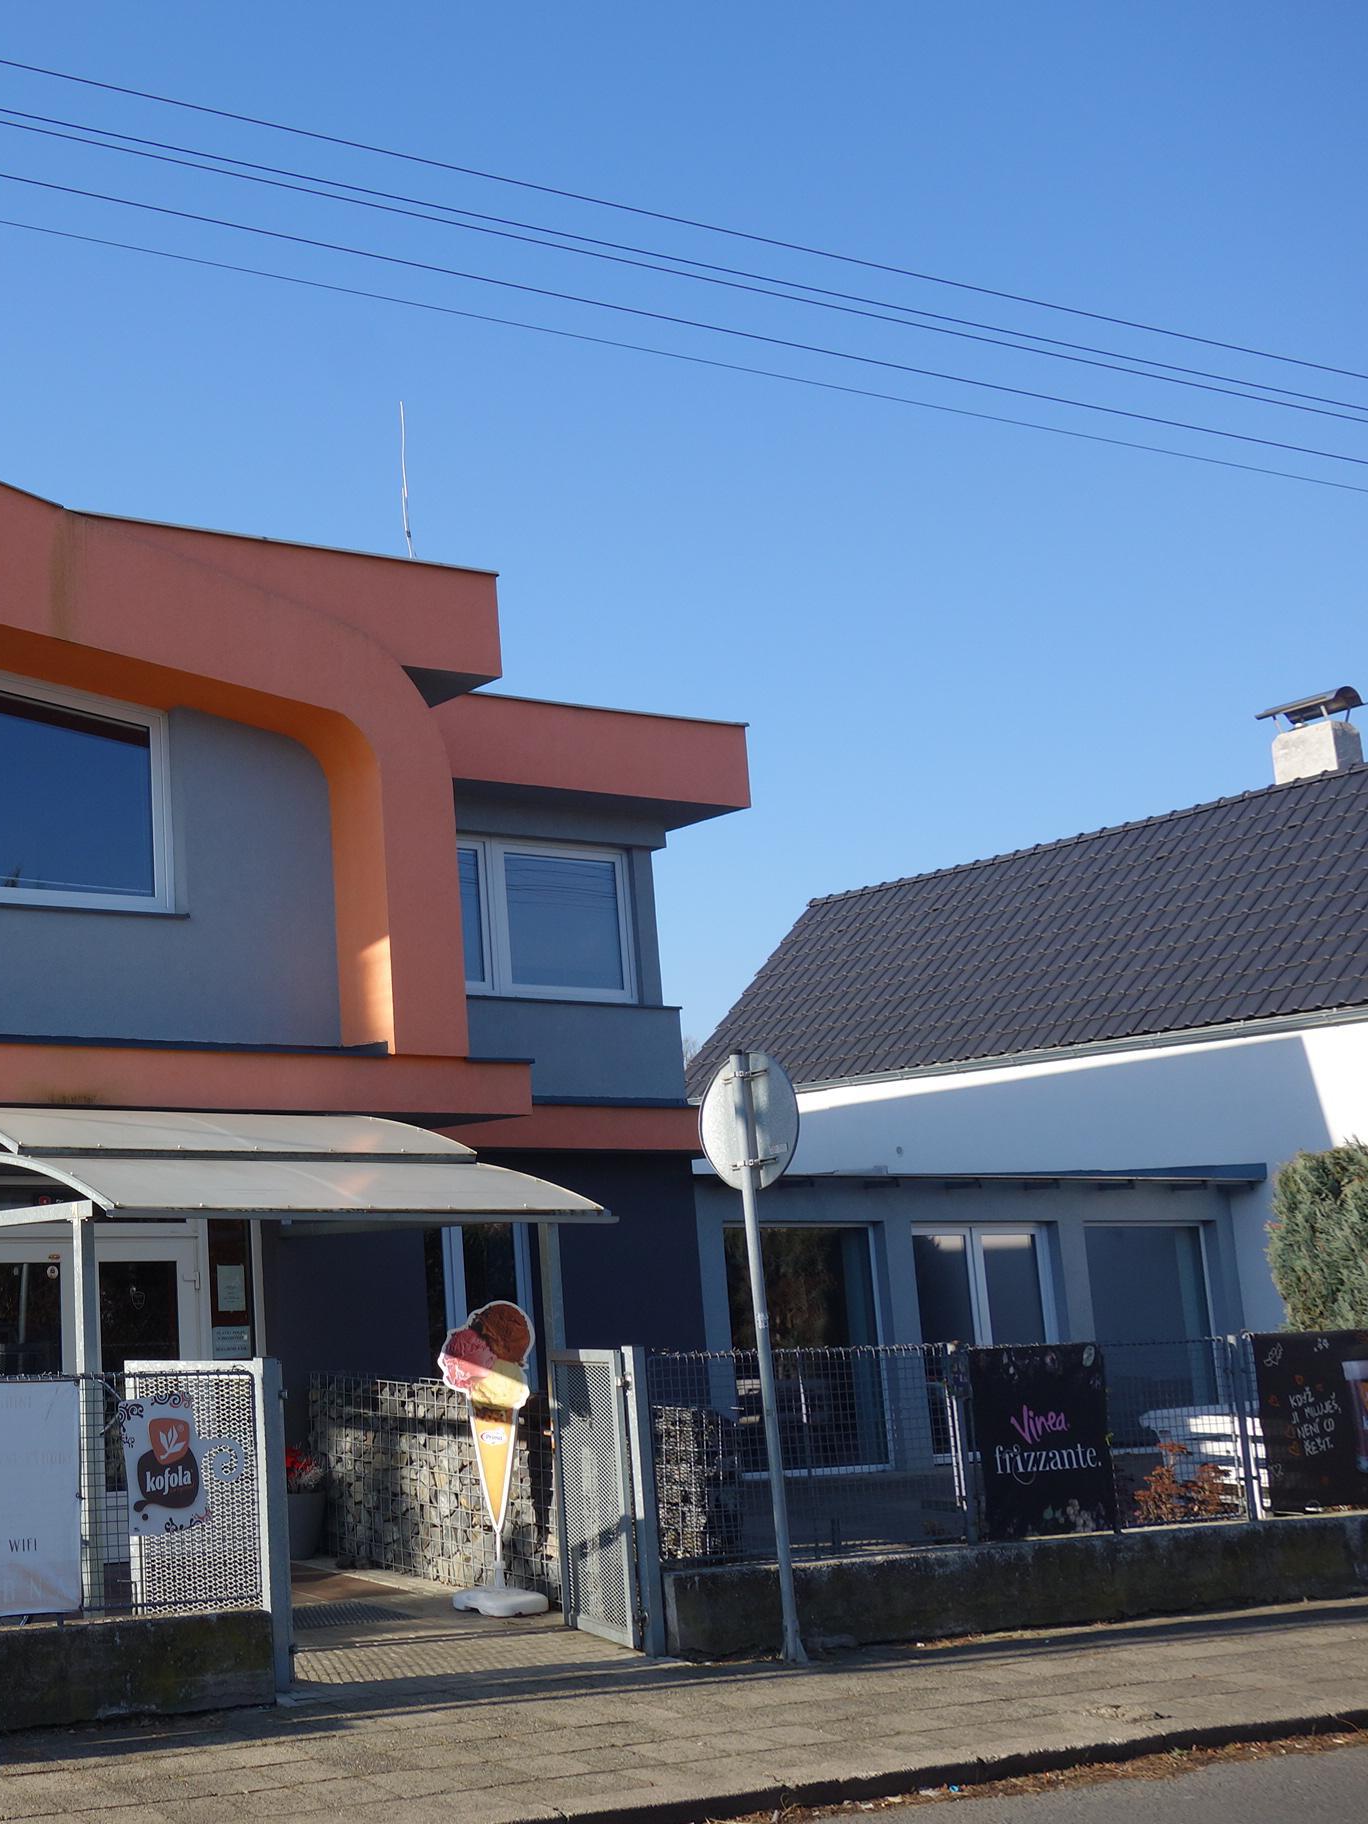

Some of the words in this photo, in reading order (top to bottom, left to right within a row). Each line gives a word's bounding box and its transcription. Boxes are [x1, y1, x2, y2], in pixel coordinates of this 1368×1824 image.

[1288, 1386, 1315, 1409] KDYŽ
[1010, 1404, 1069, 1445] Vinea
[1323, 1417, 1336, 1433] CO
[145, 1465, 192, 1496] kofola
[9, 1537, 38, 1553] WIFI
